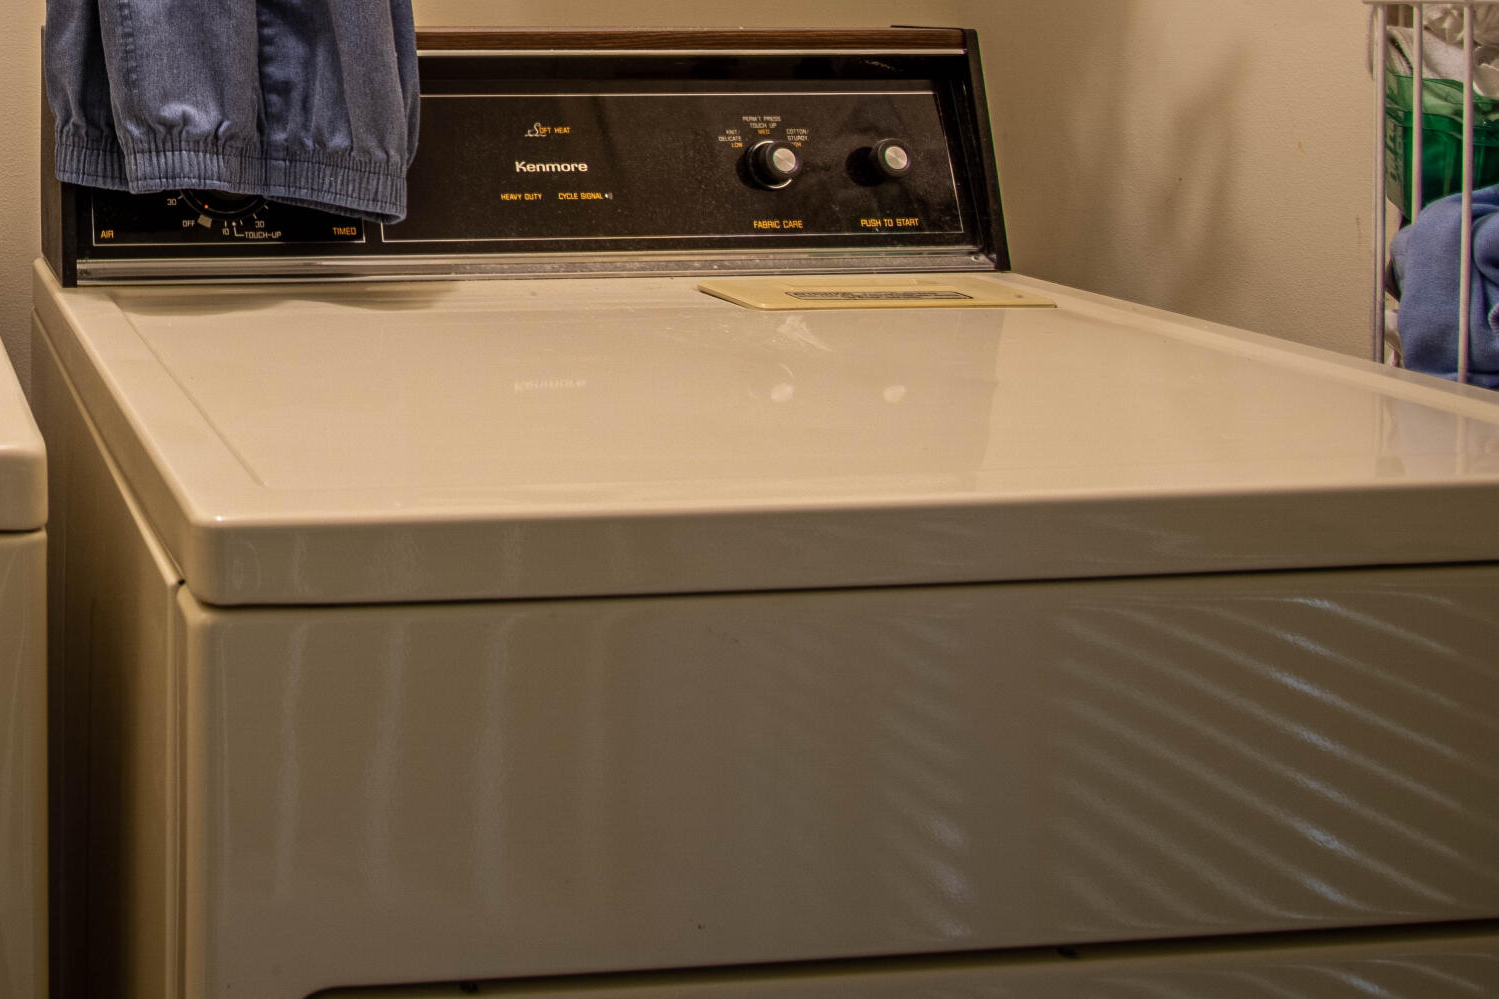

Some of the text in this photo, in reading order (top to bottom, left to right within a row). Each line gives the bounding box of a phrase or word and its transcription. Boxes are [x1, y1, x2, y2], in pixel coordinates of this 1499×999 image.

[515, 161, 588, 173] Kenmore
[580, 192, 604, 200] SIGNAL
[753, 220, 803, 229] FABRIC CARE
[860, 218, 919, 227] PUSH TO START
[100, 230, 114, 239] AIR
[245, 231, 282, 239] TOUCH-UP
[332, 227, 356, 235] TIMED
